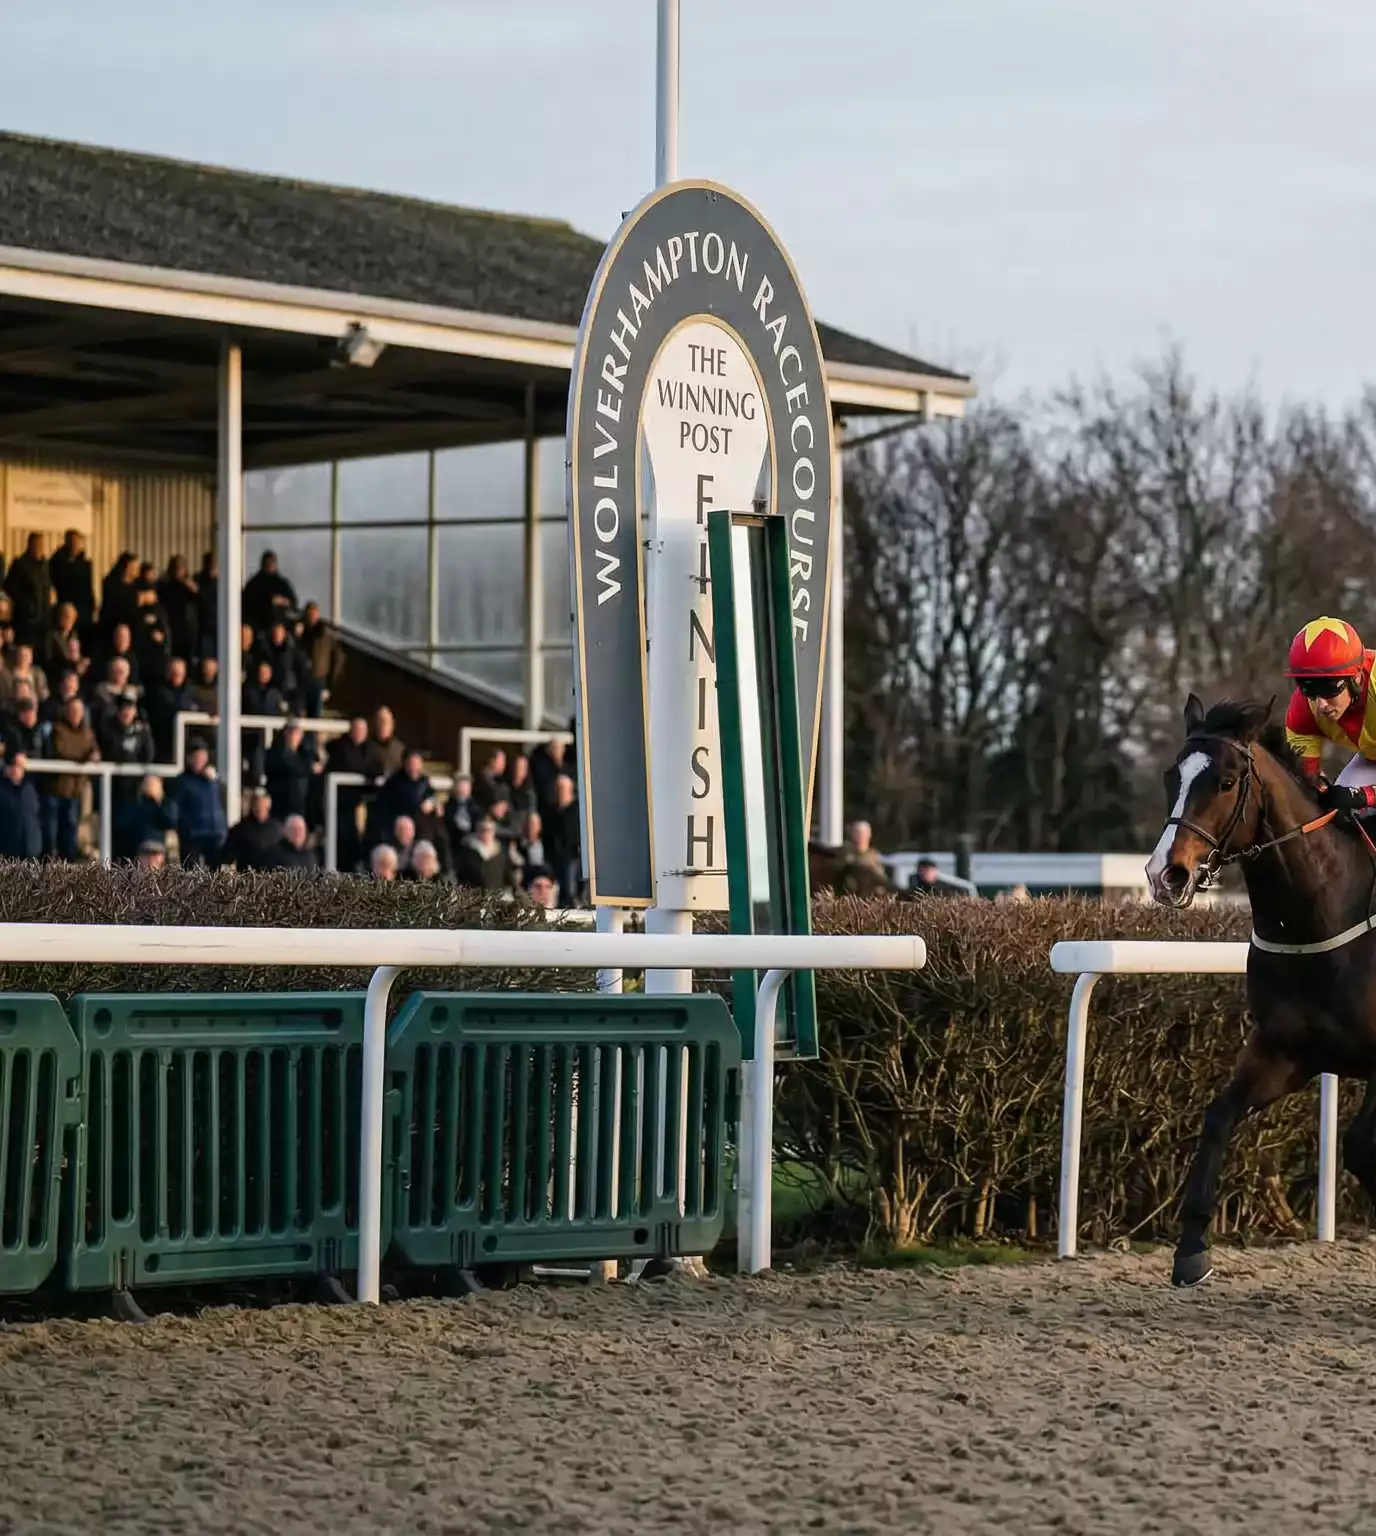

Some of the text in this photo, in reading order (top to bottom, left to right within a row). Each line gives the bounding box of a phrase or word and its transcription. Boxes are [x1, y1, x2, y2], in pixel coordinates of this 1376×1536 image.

[688, 344, 727, 377] THE
[593, 231, 749, 607] WOLVERHAMPTON
[656, 378, 756, 421] WINNING
[679, 421, 733, 455] POST
[686, 474, 716, 867] FINISH
